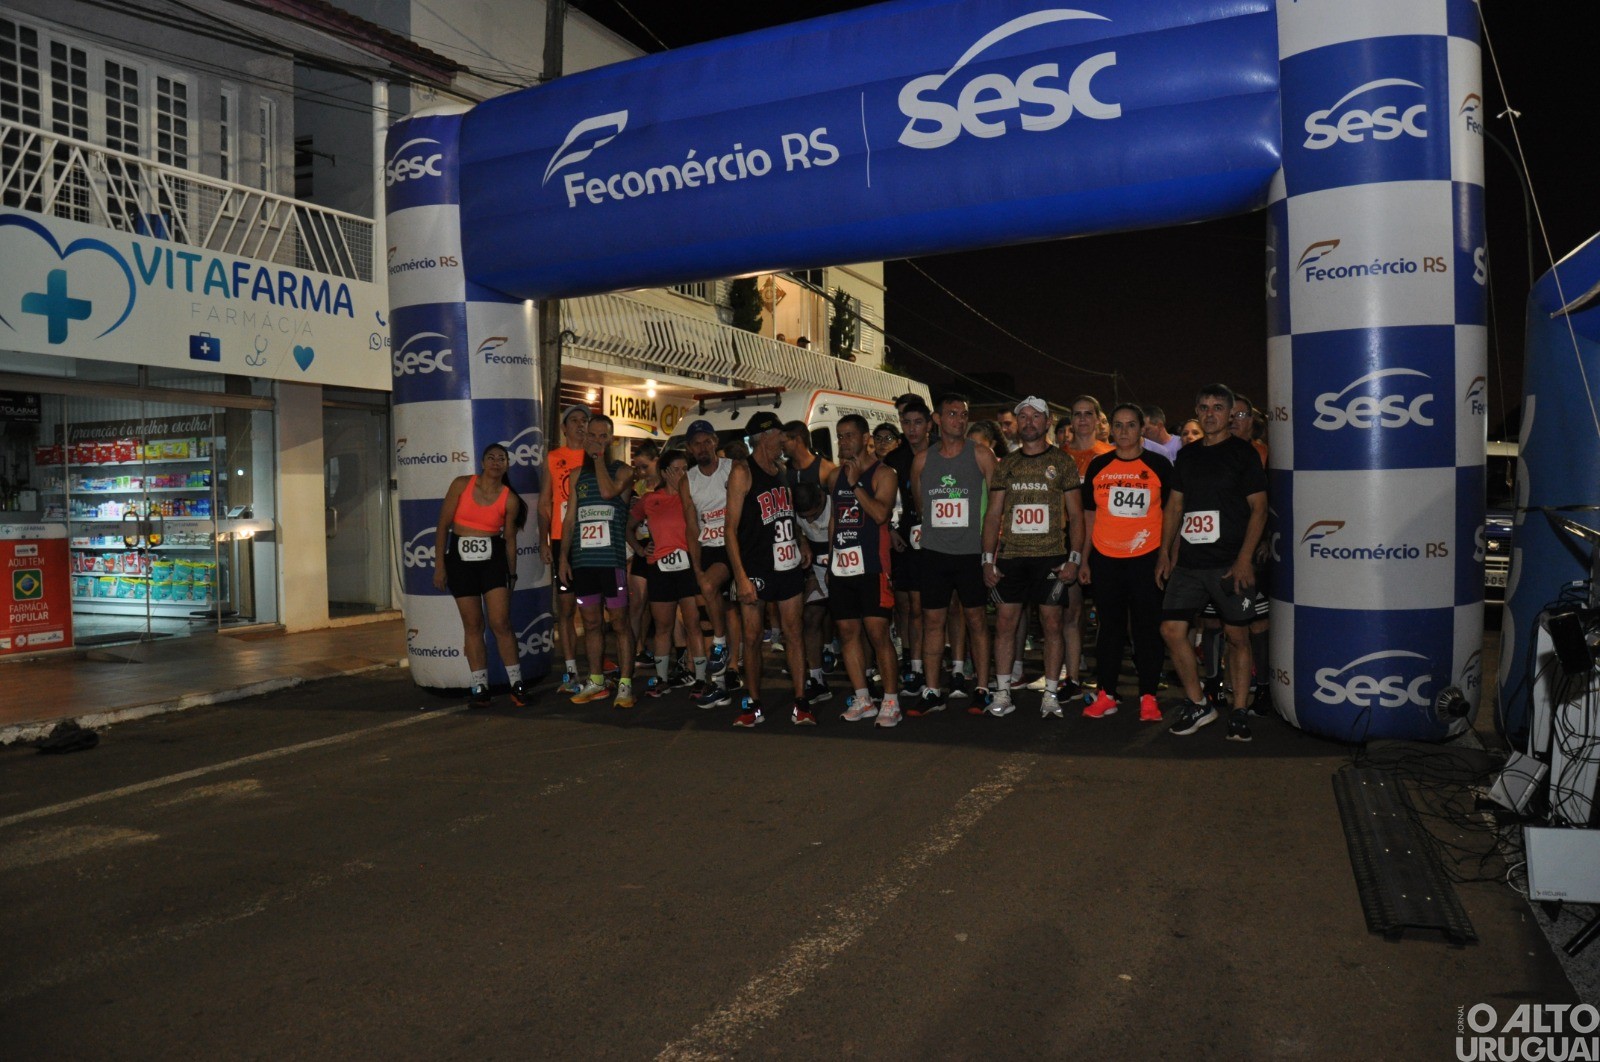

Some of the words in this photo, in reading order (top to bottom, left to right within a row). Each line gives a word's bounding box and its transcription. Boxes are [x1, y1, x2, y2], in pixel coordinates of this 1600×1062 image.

[563, 142, 772, 208] Fecomércio
[781, 126, 840, 173] RS
[439, 256, 459, 268] RS
[1305, 257, 1418, 283] Fecomércio
[1423, 256, 1448, 273] RS
[132, 242, 355, 319] VITAFARMA
[191, 302, 314, 337] FARMÁCIA
[1275, 406, 1289, 422] RS
[451, 451, 470, 463] RS
[1012, 483, 1048, 491] MASSA
[1113, 490, 1146, 509] 844
[587, 508, 611, 517] Sicredi
[935, 502, 962, 519] 301
[1015, 508, 1045, 525] 300
[581, 524, 604, 540] 221
[774, 519, 794, 543] 30
[1184, 515, 1214, 534] 293
[702, 526, 726, 541] 269
[461, 539, 488, 553] 863
[1309, 543, 1420, 560] Fecomércio
[1425, 542, 1448, 558] RS
[8, 559, 26, 567] AQUI
[29, 557, 45, 565] TEM
[836, 550, 859, 568] 209
[9, 601, 49, 613] FARMÁCIA
[9, 612, 49, 623] POPULAR
[1277, 668, 1291, 686] RS
